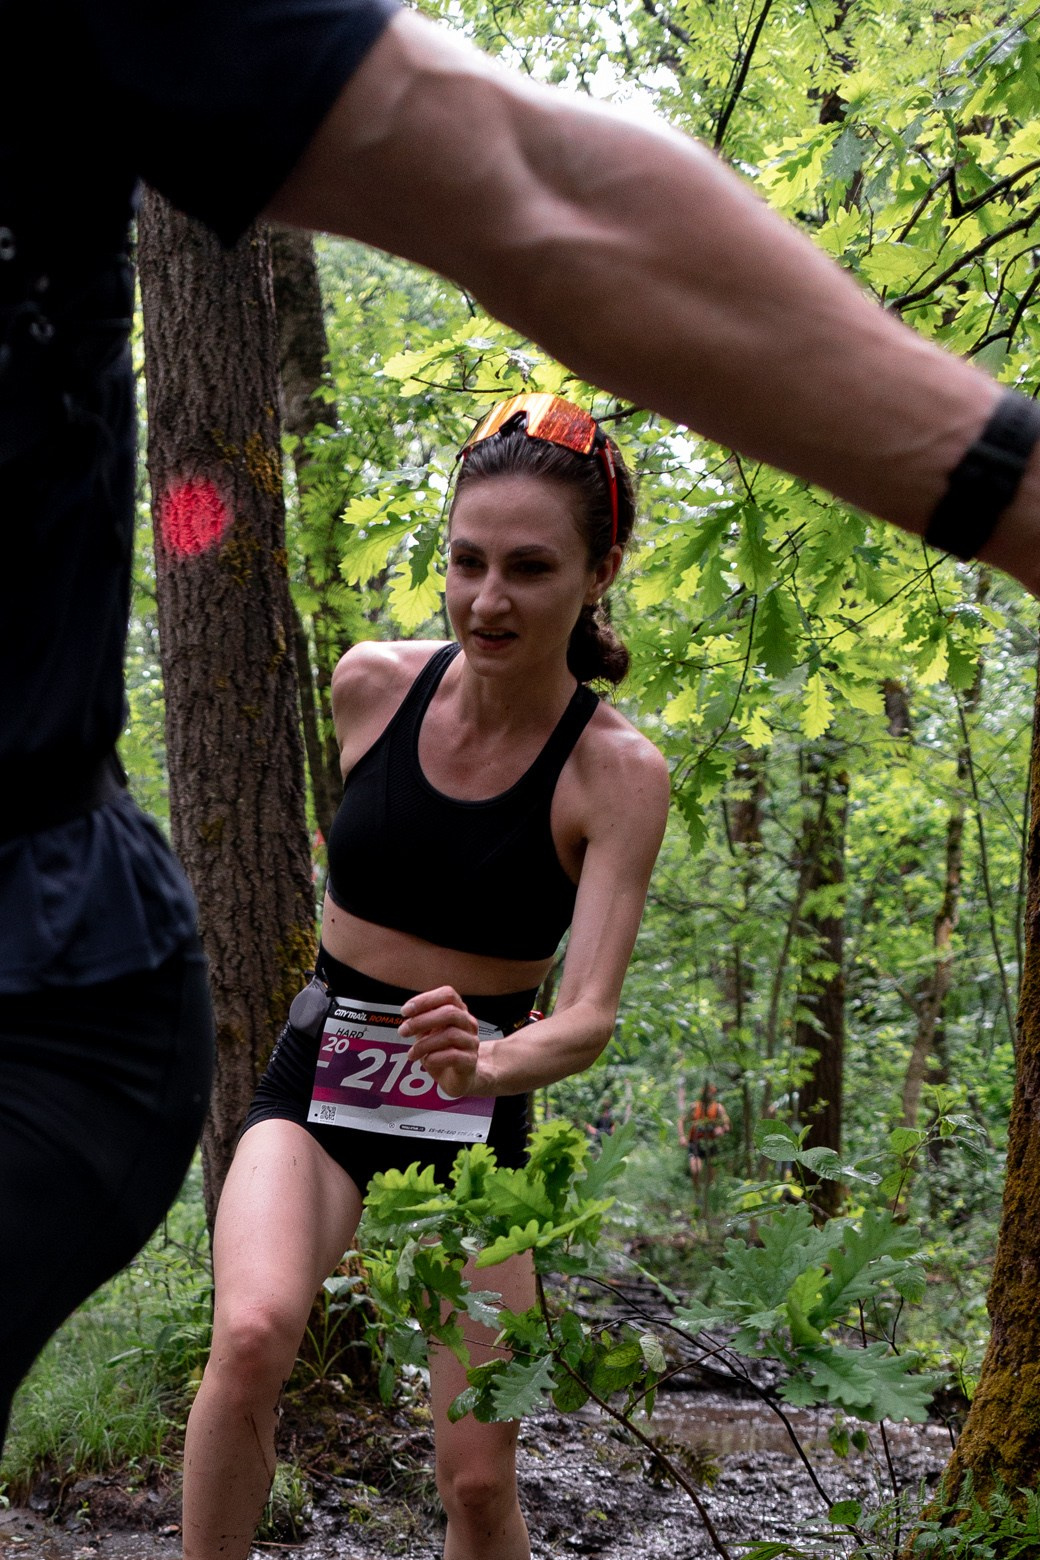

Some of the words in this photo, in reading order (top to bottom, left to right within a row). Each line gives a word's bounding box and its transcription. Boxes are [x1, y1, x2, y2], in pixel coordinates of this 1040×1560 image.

[335, 1027, 365, 1039] HARD
[321, 1036, 350, 1054] 20
[340, 1049, 463, 1100] 218
